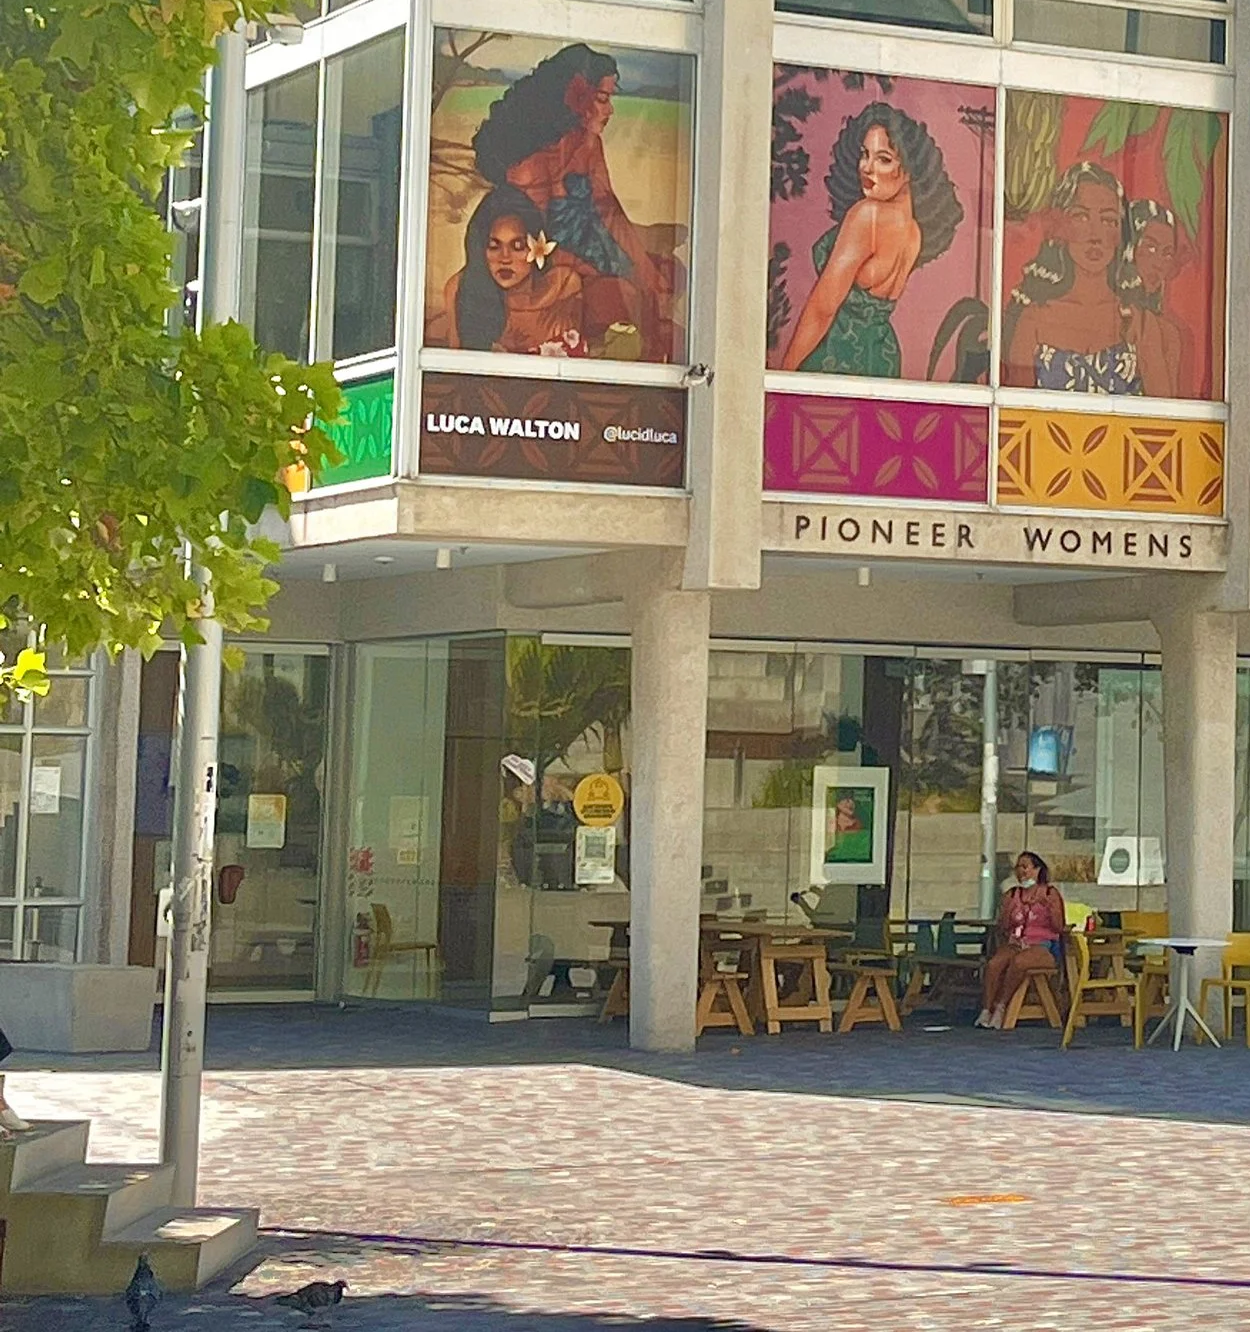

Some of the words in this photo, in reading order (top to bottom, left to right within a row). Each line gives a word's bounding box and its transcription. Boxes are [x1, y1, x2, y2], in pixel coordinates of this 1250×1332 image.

[427, 414, 485, 434] LUCA
[490, 417, 580, 440] WALTON
[604, 426, 677, 444] @lucidluca
[795, 515, 975, 548] PIONEER
[1023, 526, 1192, 557] WOMENS
